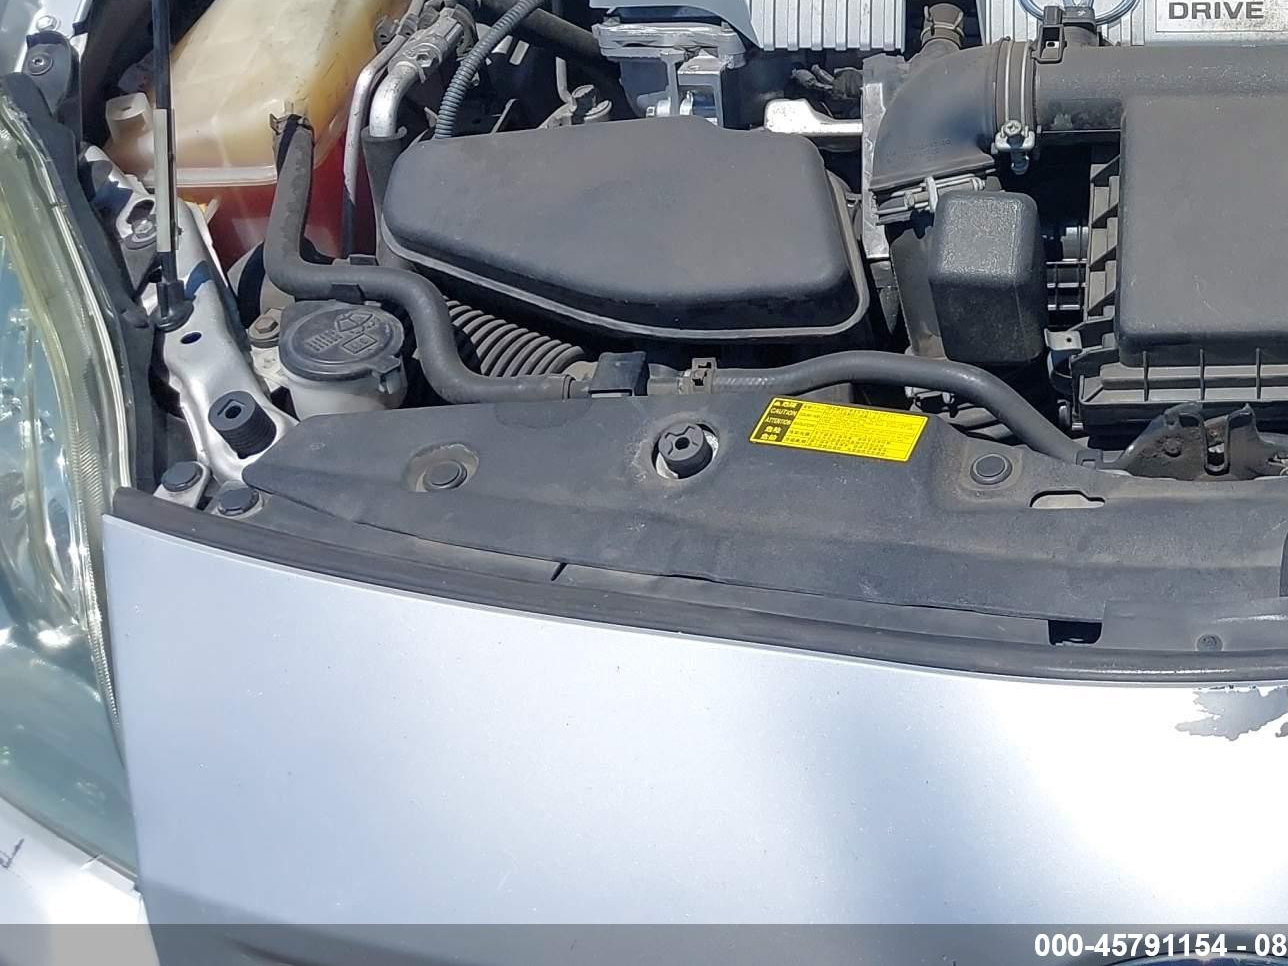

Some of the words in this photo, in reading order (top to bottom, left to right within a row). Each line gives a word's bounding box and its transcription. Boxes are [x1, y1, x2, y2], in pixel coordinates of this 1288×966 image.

[1169, 1, 1264, 20] DRIVE
[770, 407, 797, 416] CAUTION
[766, 417, 792, 426] ATTENTION
